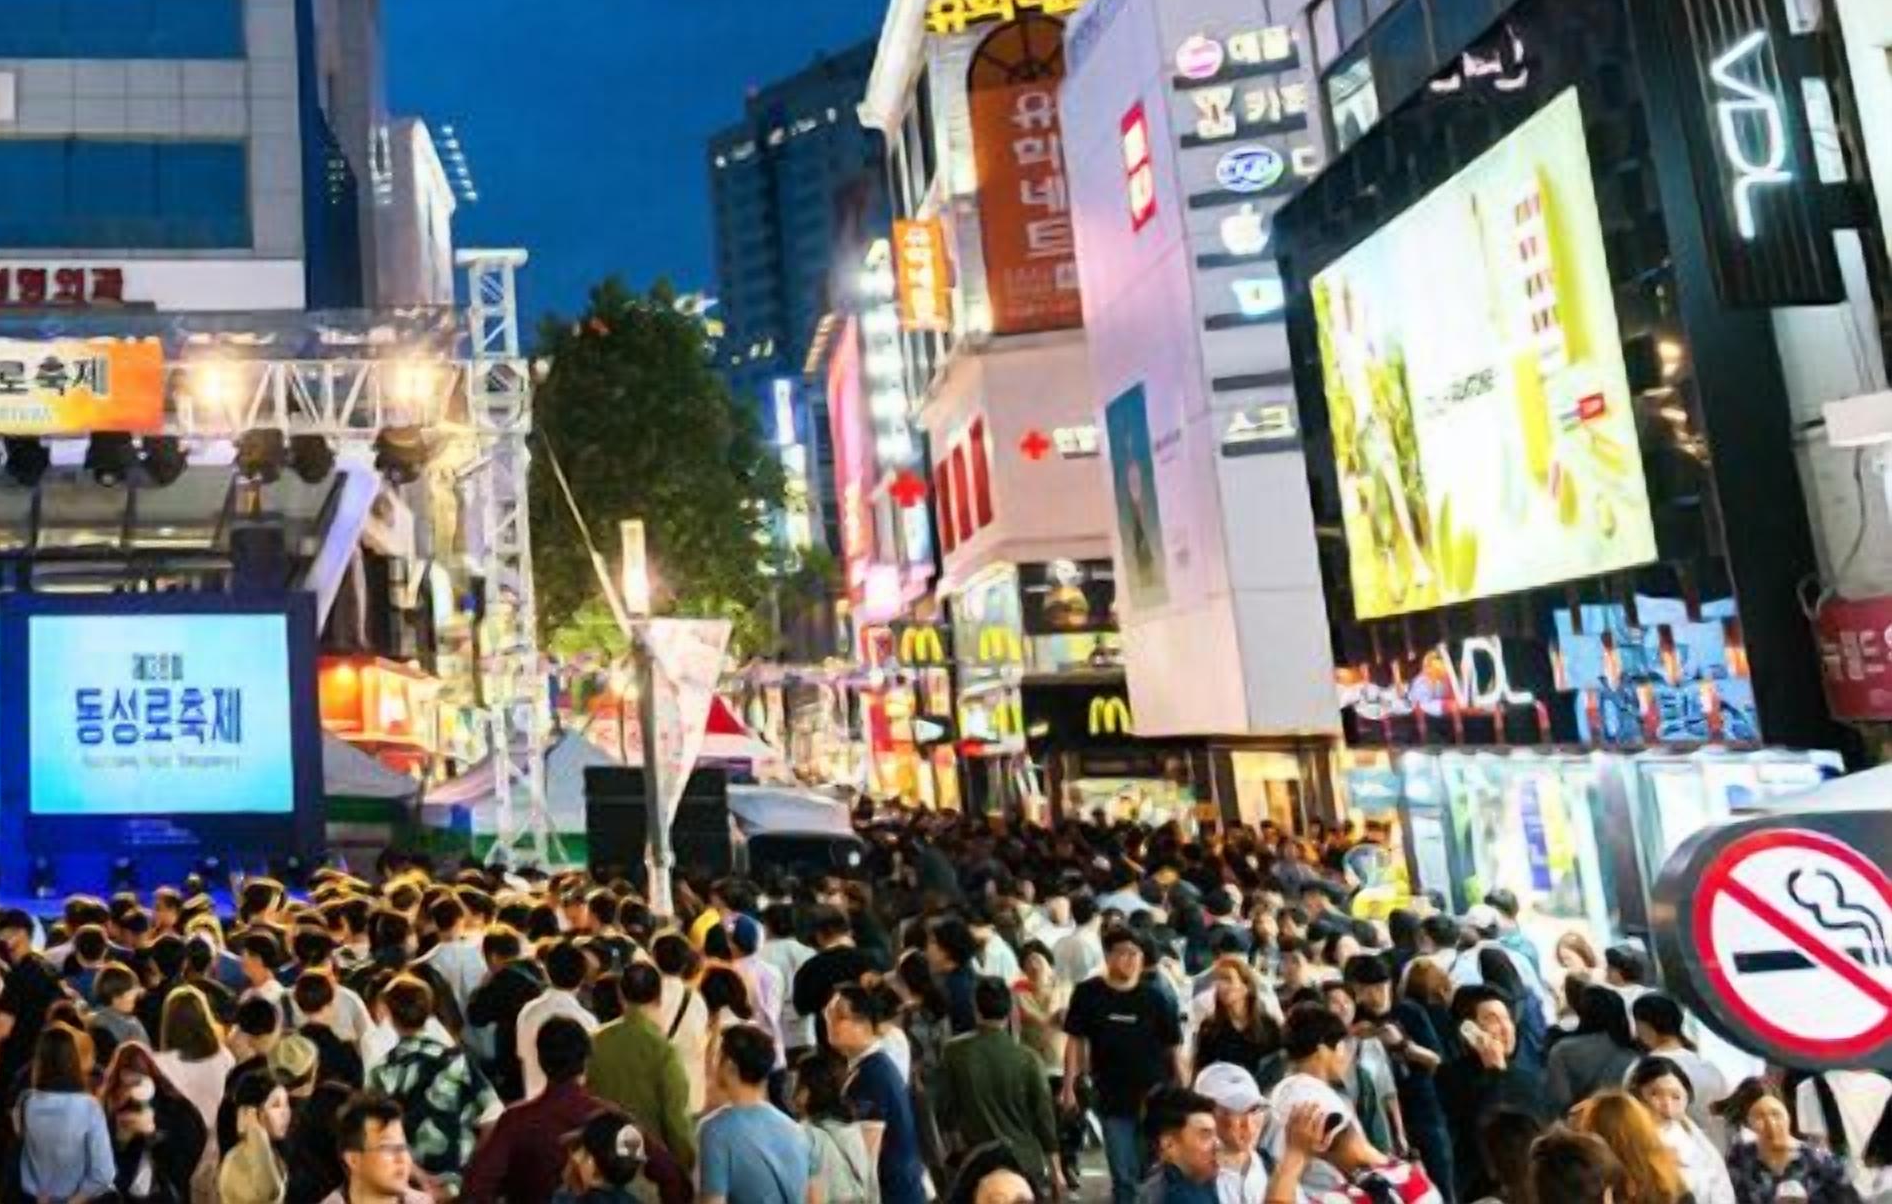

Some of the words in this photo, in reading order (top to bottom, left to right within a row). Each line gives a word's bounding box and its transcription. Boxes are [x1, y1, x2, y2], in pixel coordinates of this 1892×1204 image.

[1711, 29, 1793, 240] VDL
[1437, 634, 1534, 708] VDL
[74, 687, 243, 746] 동성로축제
